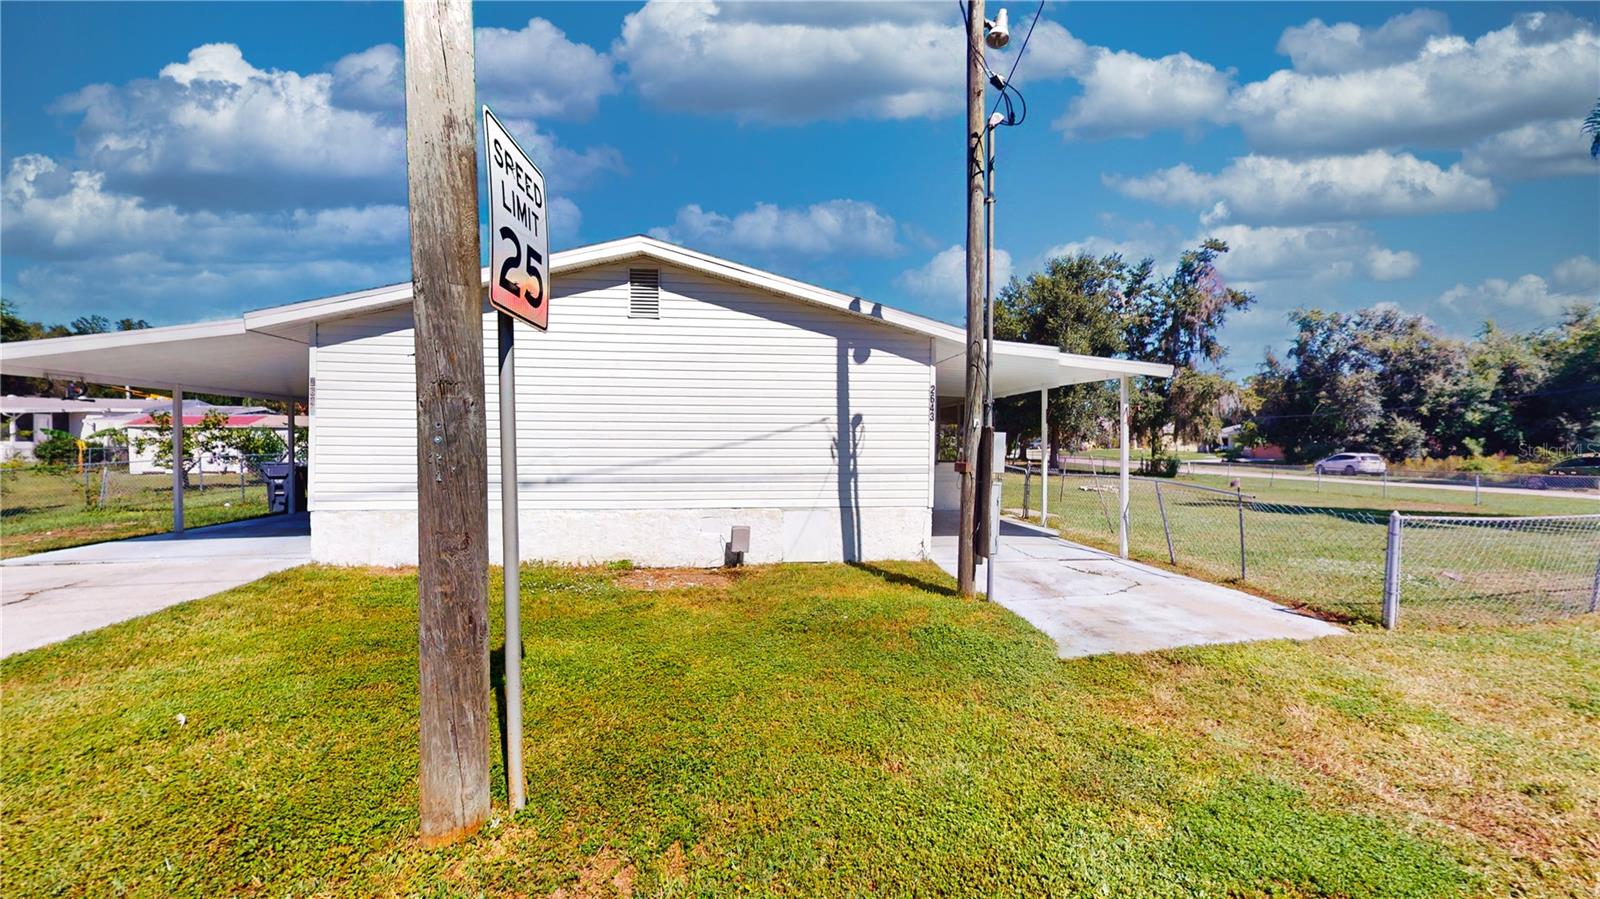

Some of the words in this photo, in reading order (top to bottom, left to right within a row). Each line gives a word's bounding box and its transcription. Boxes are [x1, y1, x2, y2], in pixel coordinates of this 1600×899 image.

[493, 138, 542, 208] SPEED
[501, 180, 539, 237] LIMIT
[499, 226, 544, 309] 25
